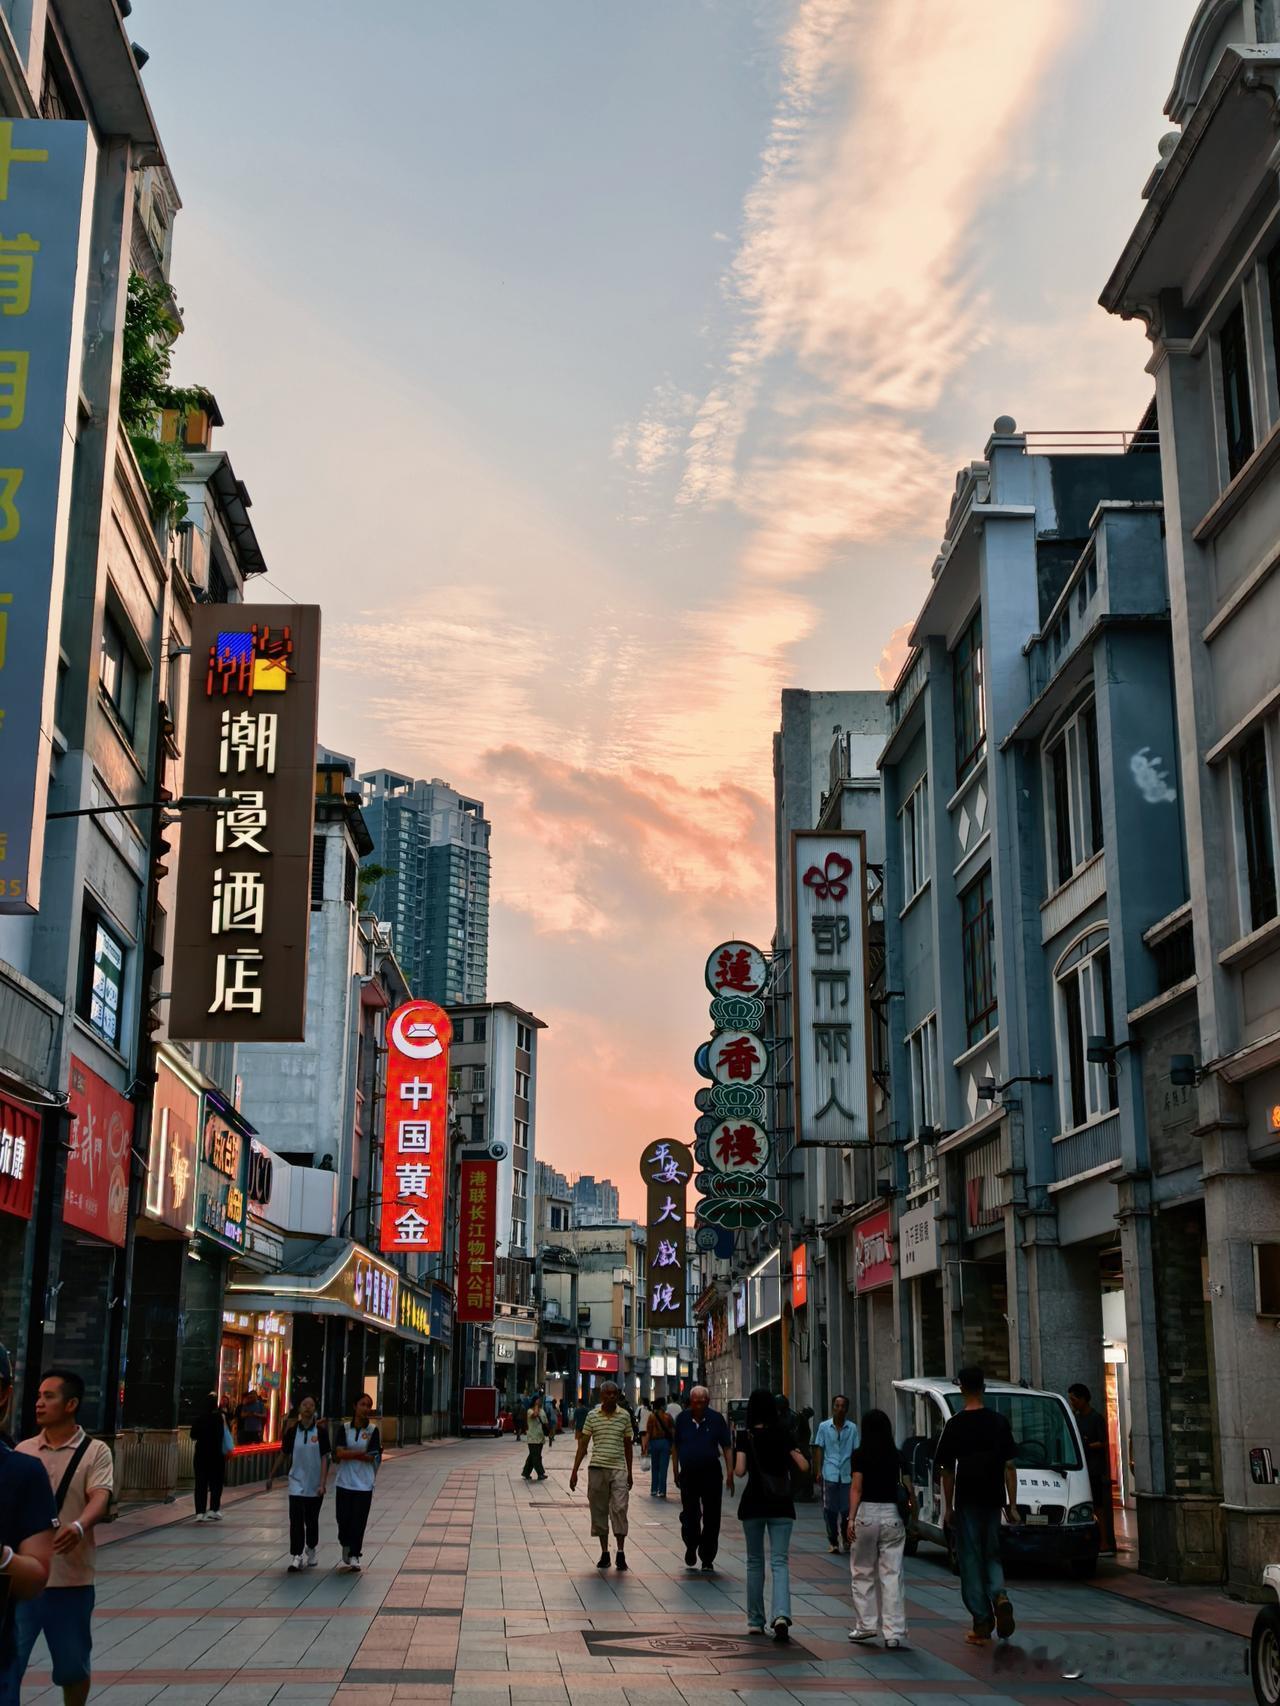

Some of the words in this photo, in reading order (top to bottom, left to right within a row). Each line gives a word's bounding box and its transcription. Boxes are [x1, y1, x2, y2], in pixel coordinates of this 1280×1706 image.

[208, 710, 278, 1014] 潮漫酒店
[715, 949, 763, 1167] 蓮香樓
[811, 914, 855, 1121] 都市丽人
[393, 1076, 433, 1244] 中国黄金
[466, 1170, 488, 1310] 港联长江物管公司
